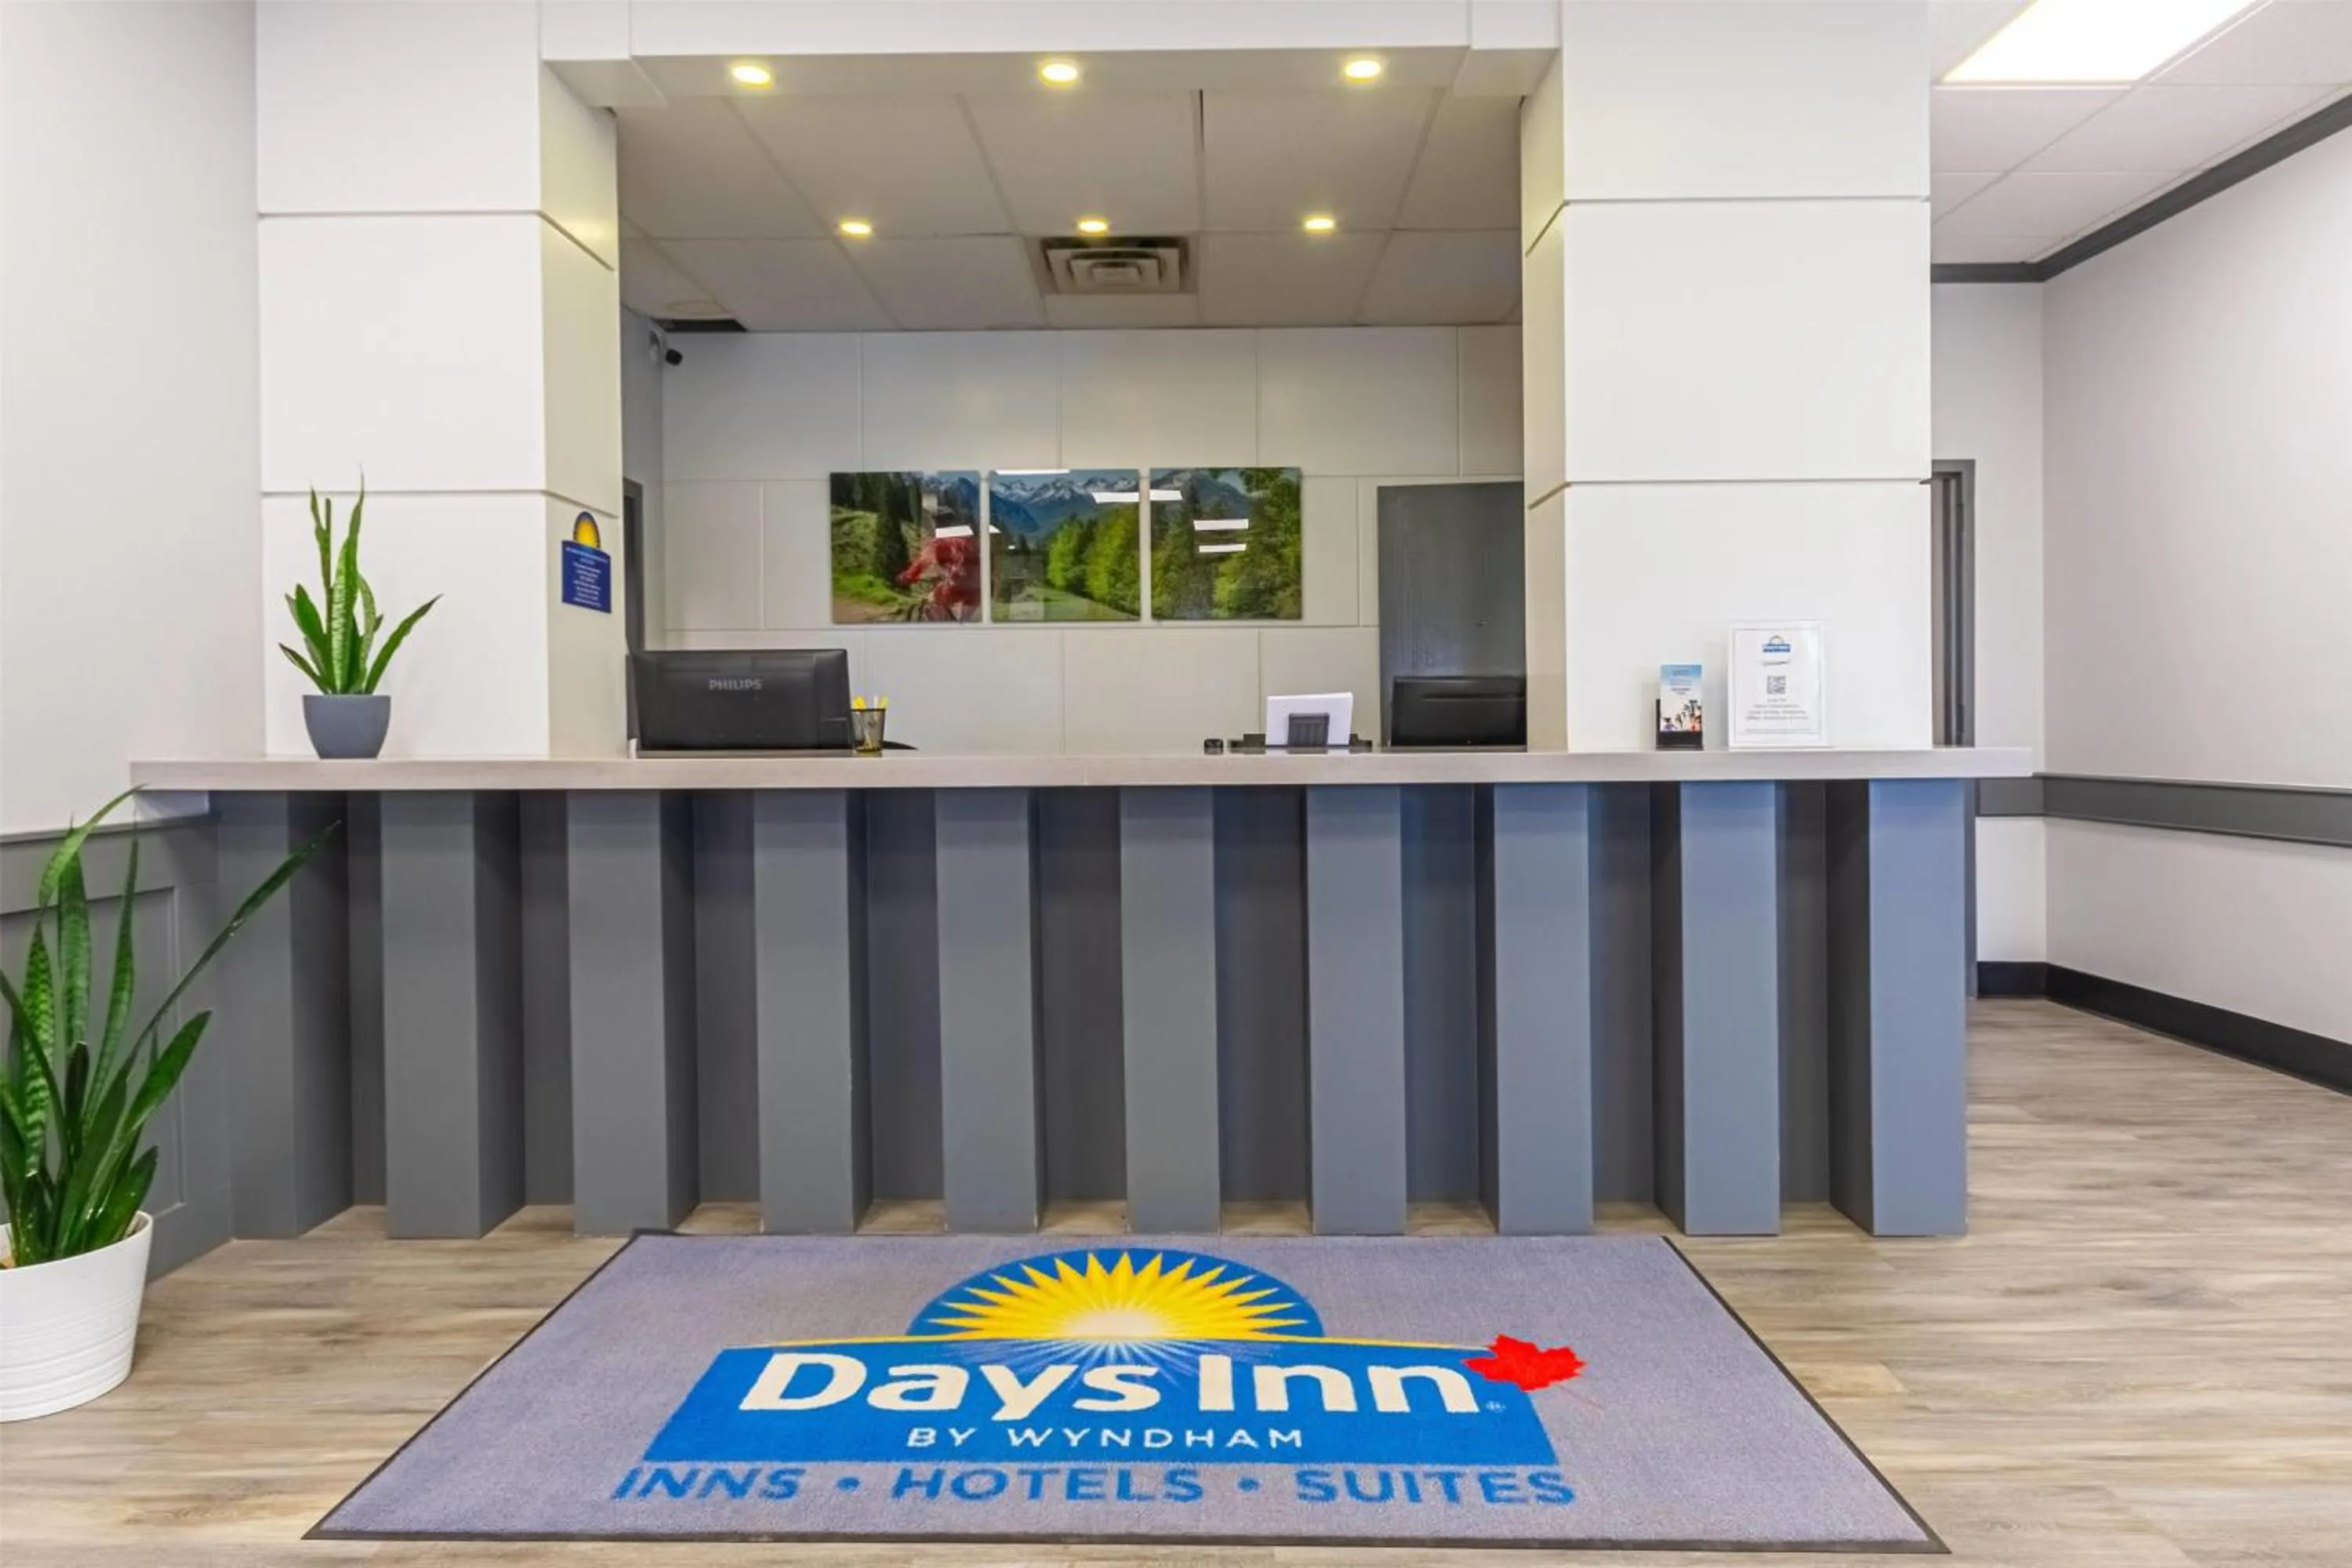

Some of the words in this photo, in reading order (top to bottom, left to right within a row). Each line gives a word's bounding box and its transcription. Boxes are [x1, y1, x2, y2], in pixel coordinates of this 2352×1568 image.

[709, 678, 763, 690] PHILIPS
[740, 1353, 1160, 1421] Days
[1200, 1354, 1479, 1412] Inn
[909, 1428, 973, 1446] BY
[1009, 1428, 1301, 1446] WYNDHAM
[612, 1467, 806, 1500] INNS
[891, 1467, 1203, 1502] HOTELS
[1295, 1468, 1575, 1505] SUITES
